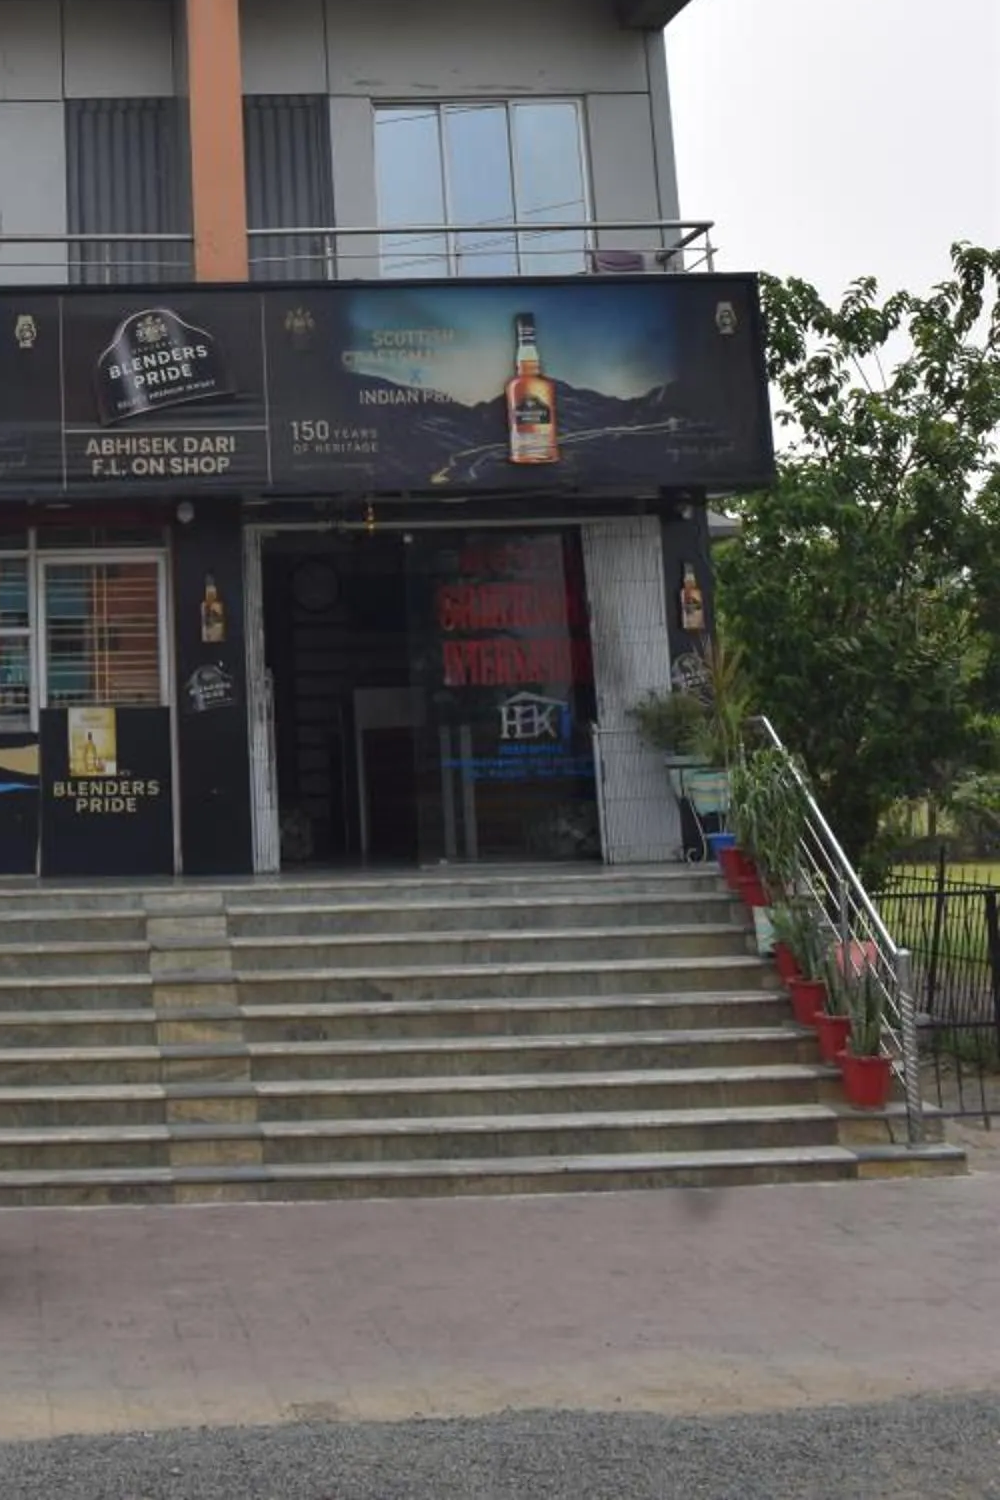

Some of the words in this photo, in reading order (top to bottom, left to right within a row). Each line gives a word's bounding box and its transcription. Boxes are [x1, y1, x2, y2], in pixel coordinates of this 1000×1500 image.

[109, 344, 208, 380] BLENDERS
[133, 363, 193, 389] PRIDE
[359, 389, 420, 406] INDIAN
[290, 420, 330, 442] 150
[85, 436, 178, 456] ABHISEK
[183, 435, 236, 454] DARI
[91, 458, 127, 476] F.L.
[131, 456, 165, 475] ON
[169, 455, 231, 474] SHOP
[53, 780, 160, 797] BLENDERS
[75, 797, 138, 814] PRIDE
